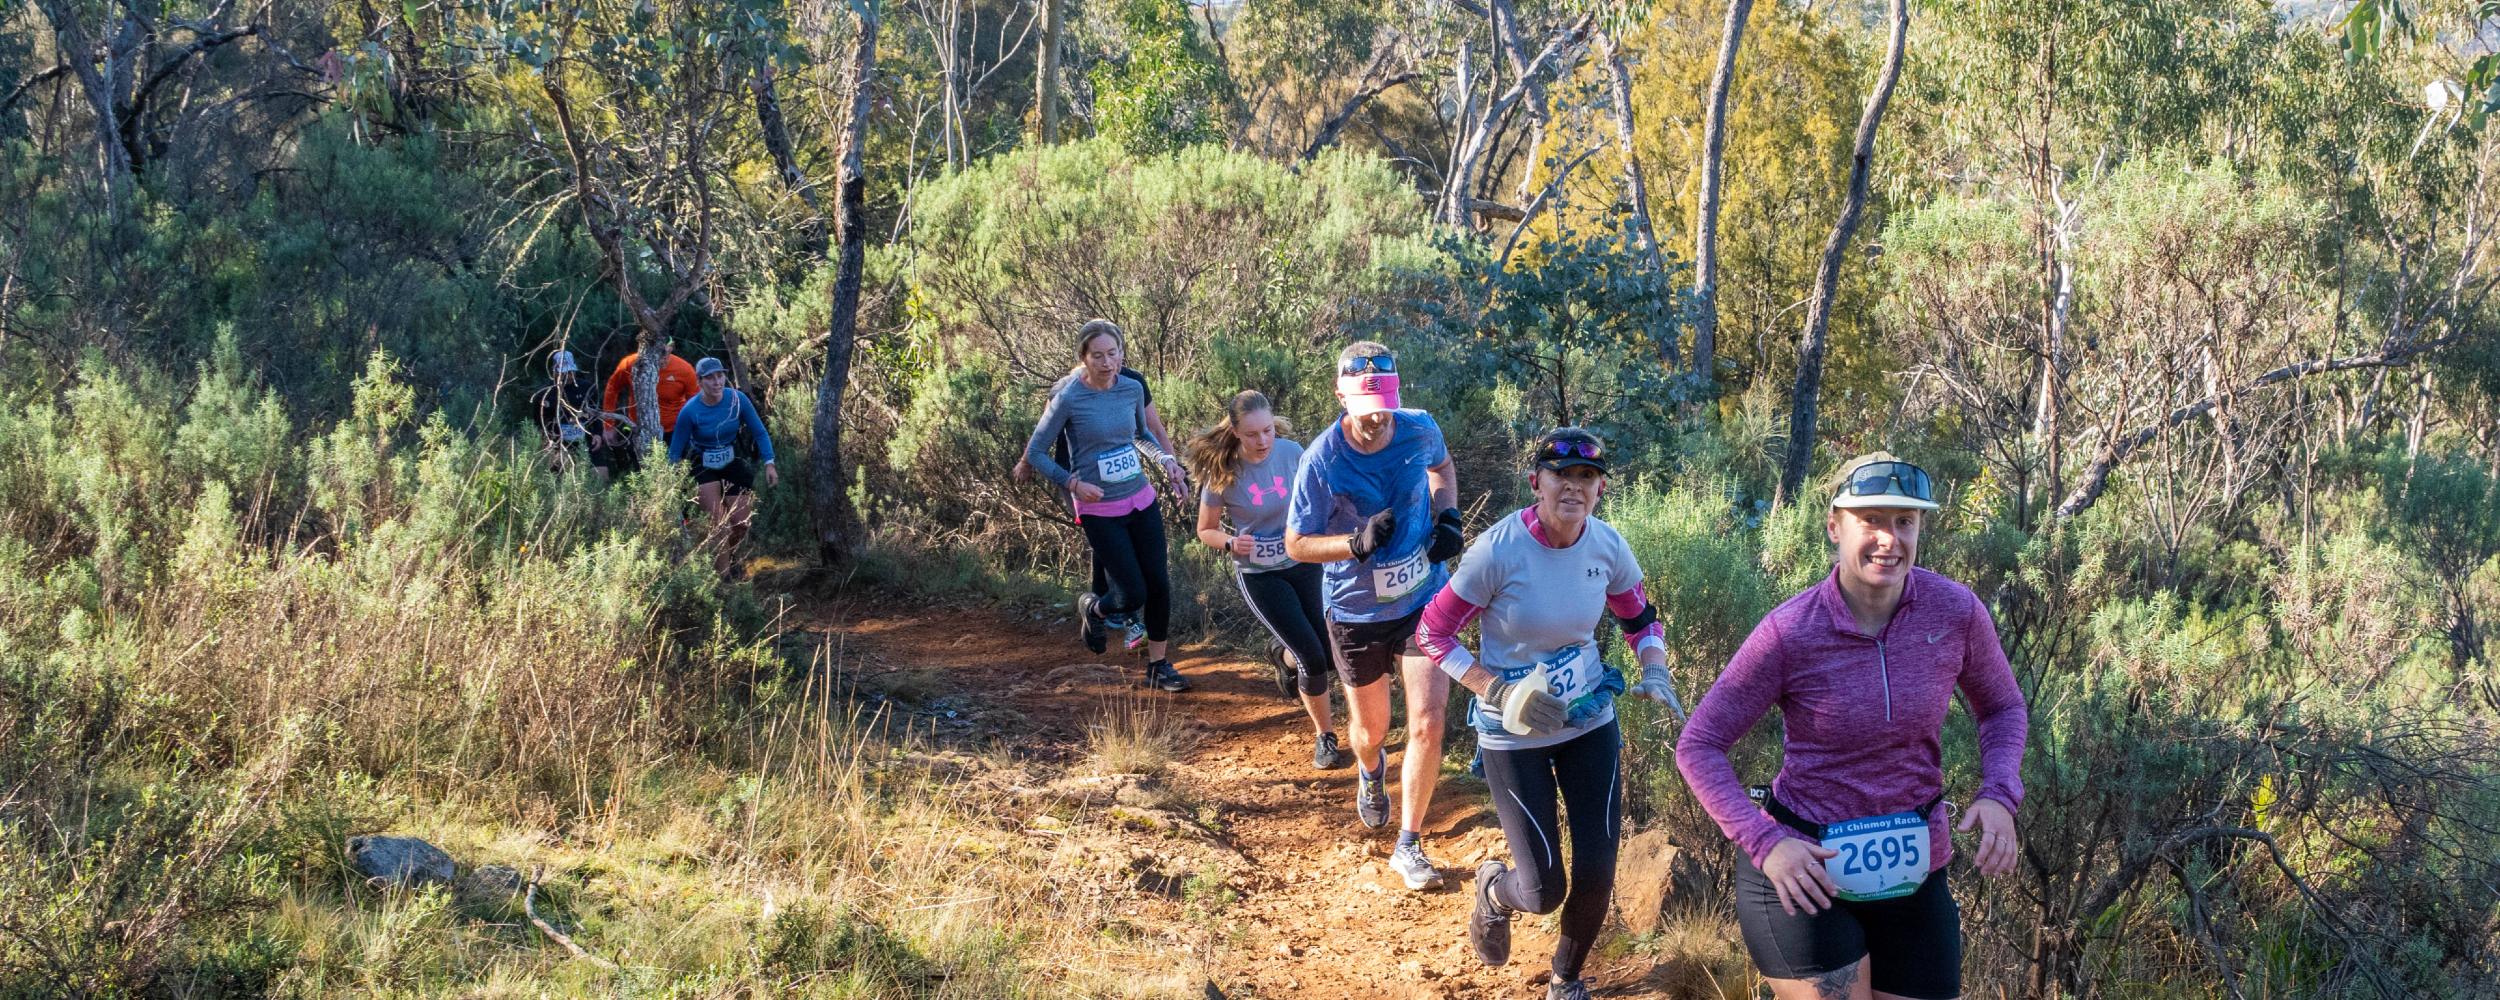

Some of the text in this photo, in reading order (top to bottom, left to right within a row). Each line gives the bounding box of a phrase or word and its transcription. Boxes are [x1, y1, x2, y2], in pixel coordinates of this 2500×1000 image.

[1105, 454, 1136, 475] 2588
[1256, 542, 1286, 558] 258
[1384, 556, 1424, 588] 2673
[1827, 815, 1922, 837] Sri Chinmoy Races
[1839, 833, 1921, 876] 2695
